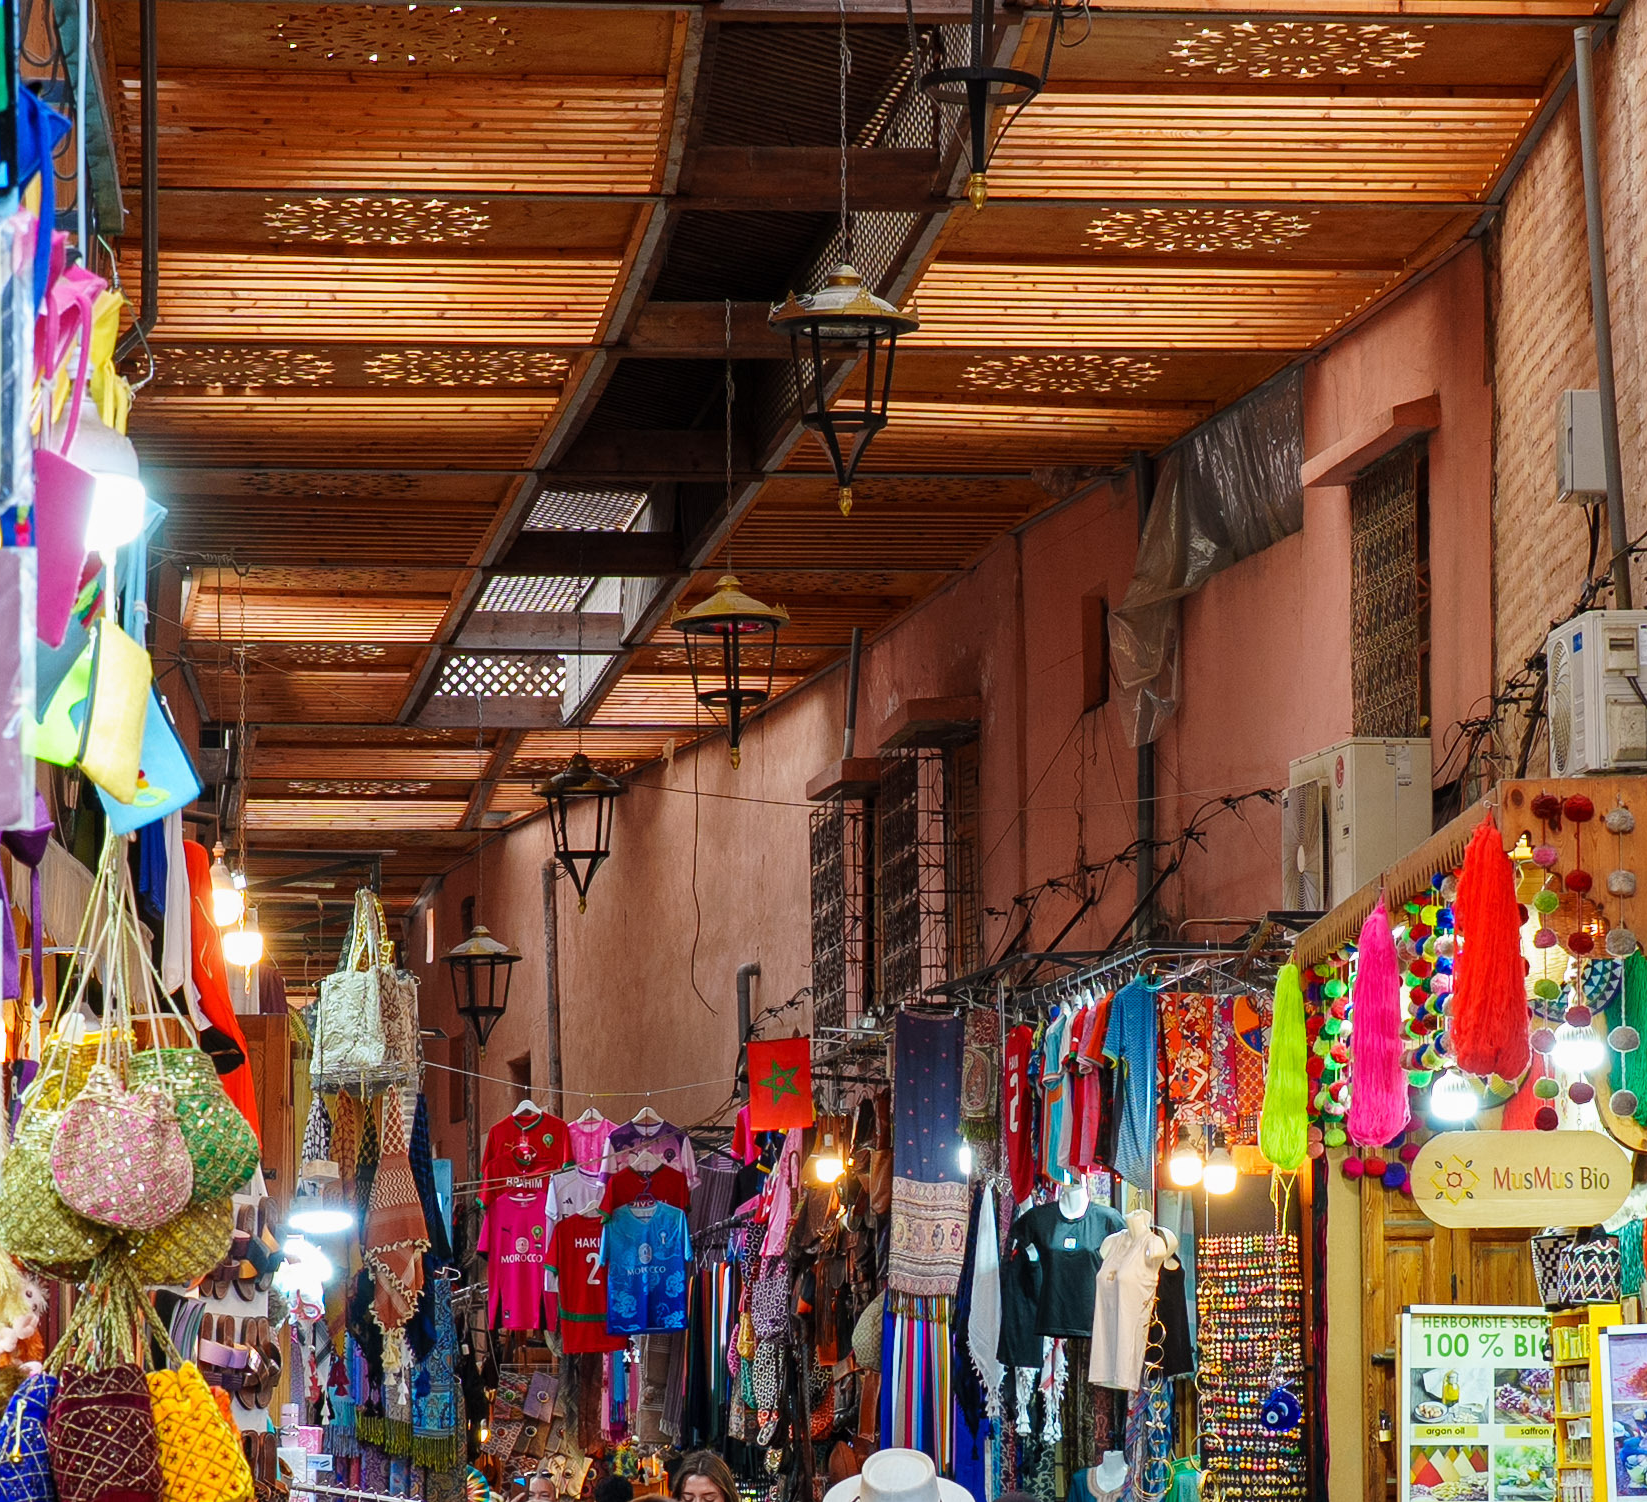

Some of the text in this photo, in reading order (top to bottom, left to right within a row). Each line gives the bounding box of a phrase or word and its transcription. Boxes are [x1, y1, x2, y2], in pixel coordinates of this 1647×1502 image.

[1492, 1166, 1611, 1190] MusMus Bio
[574, 1238, 601, 1249] HAKI
[500, 1252, 543, 1265] MOROCCO
[1422, 1315, 1507, 1329] HERBORISTE
[1423, 1333, 1470, 1358] 100
[1478, 1332, 1504, 1359] %
[1426, 1426, 1466, 1437] argan oil
[1520, 1426, 1550, 1436] saffron
